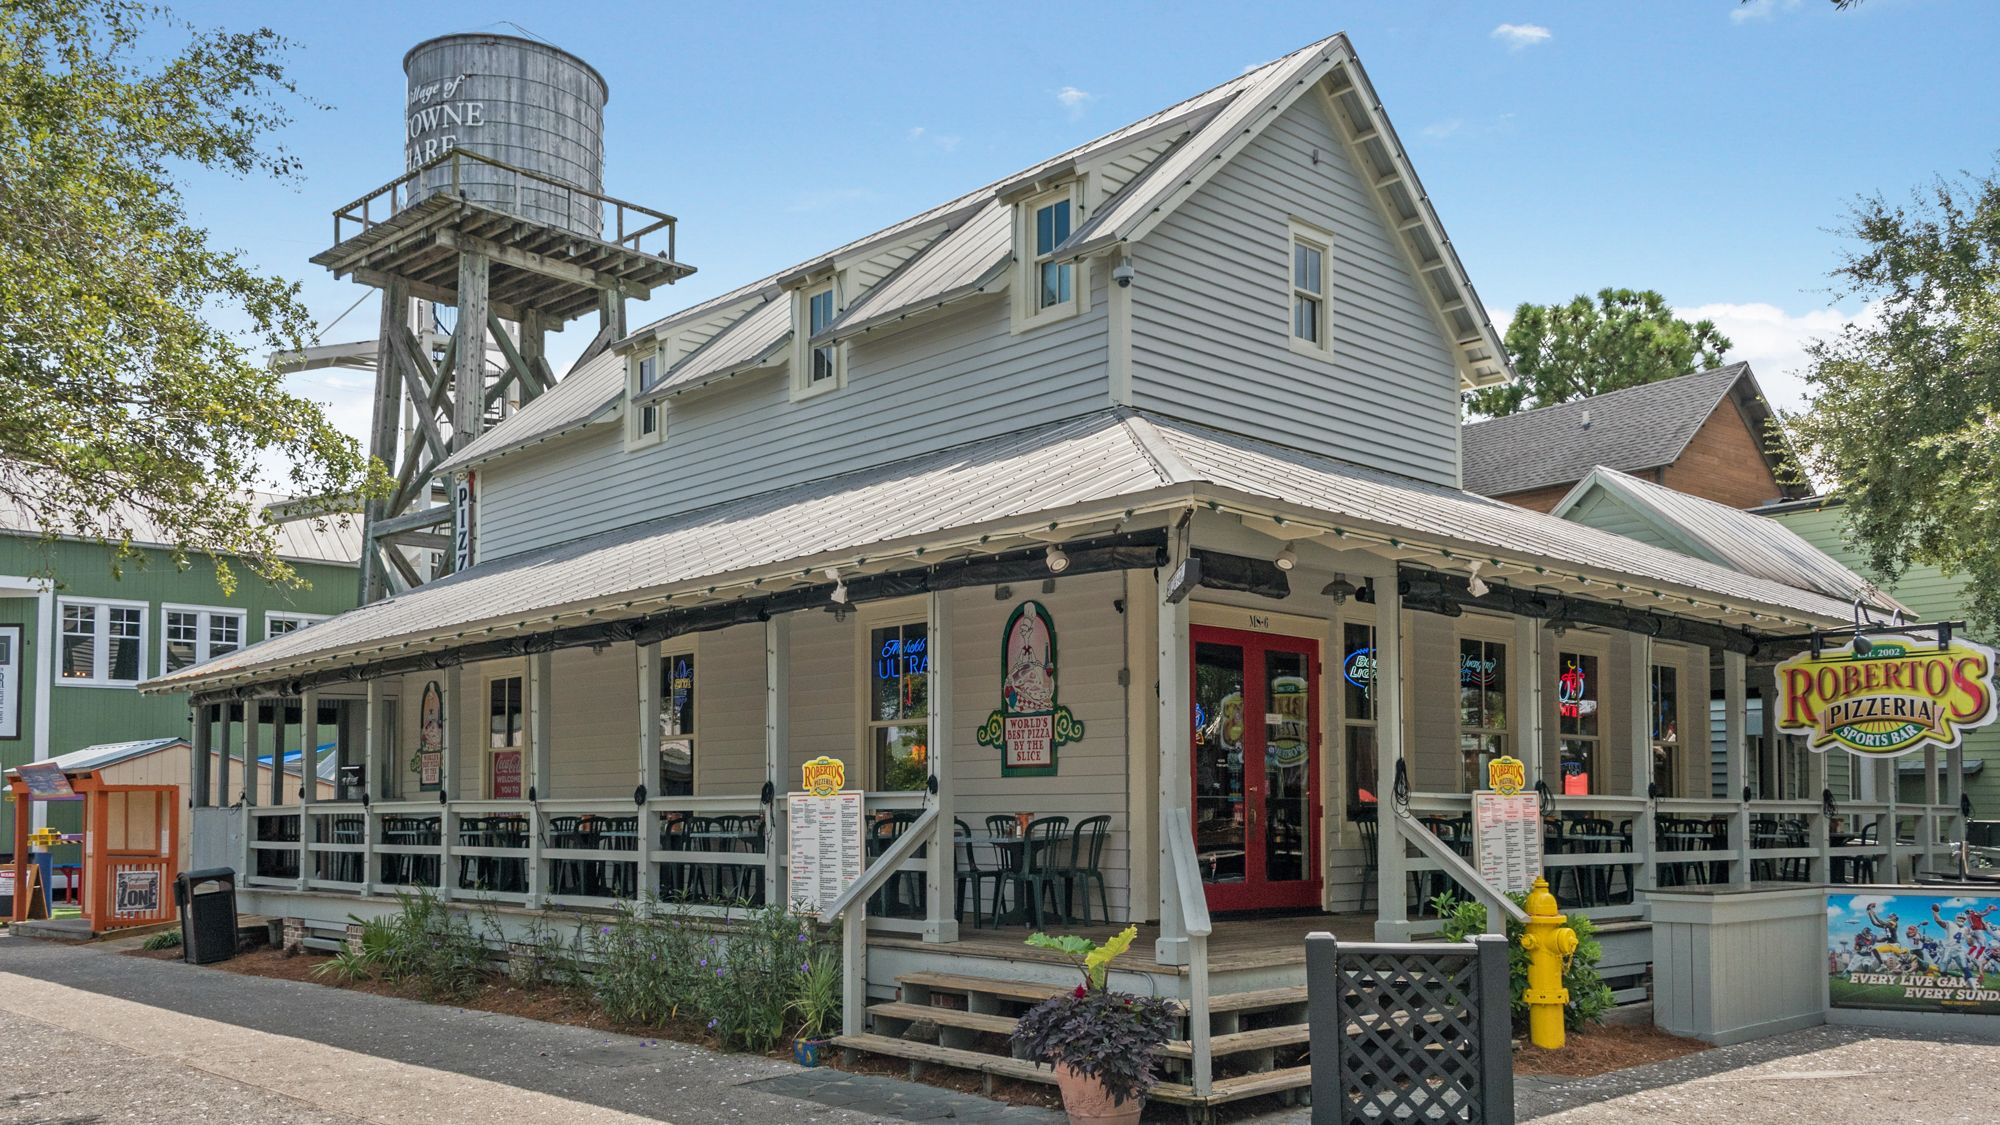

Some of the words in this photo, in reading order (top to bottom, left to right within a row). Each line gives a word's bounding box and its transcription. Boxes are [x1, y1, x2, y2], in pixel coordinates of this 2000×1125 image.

[409, 83, 439, 104] illage
[443, 75, 465, 98] of
[408, 102, 485, 138] OWNE
[458, 487, 467, 571] PIZZ
[1877, 648, 1900, 657] 2002
[1783, 655, 1983, 724] ROBERTO'S
[1830, 697, 1932, 724] PIZZERIA
[1010, 718, 1047, 728] WORLD'S
[1007, 729, 1025, 740] BEST
[1027, 728, 1050, 739] PIZZA
[1840, 726, 1888, 747] SPORTS
[1890, 724, 1918, 745] BAR
[1014, 741, 1024, 751] BY
[1027, 739, 1044, 750] THE
[1016, 751, 1041, 762] SLICE
[1849, 973, 1896, 985] EVERY
[1899, 975, 1935, 987] LIVE
[1904, 987, 1954, 999] EVERY
[1955, 989, 2000, 1001] SUND
